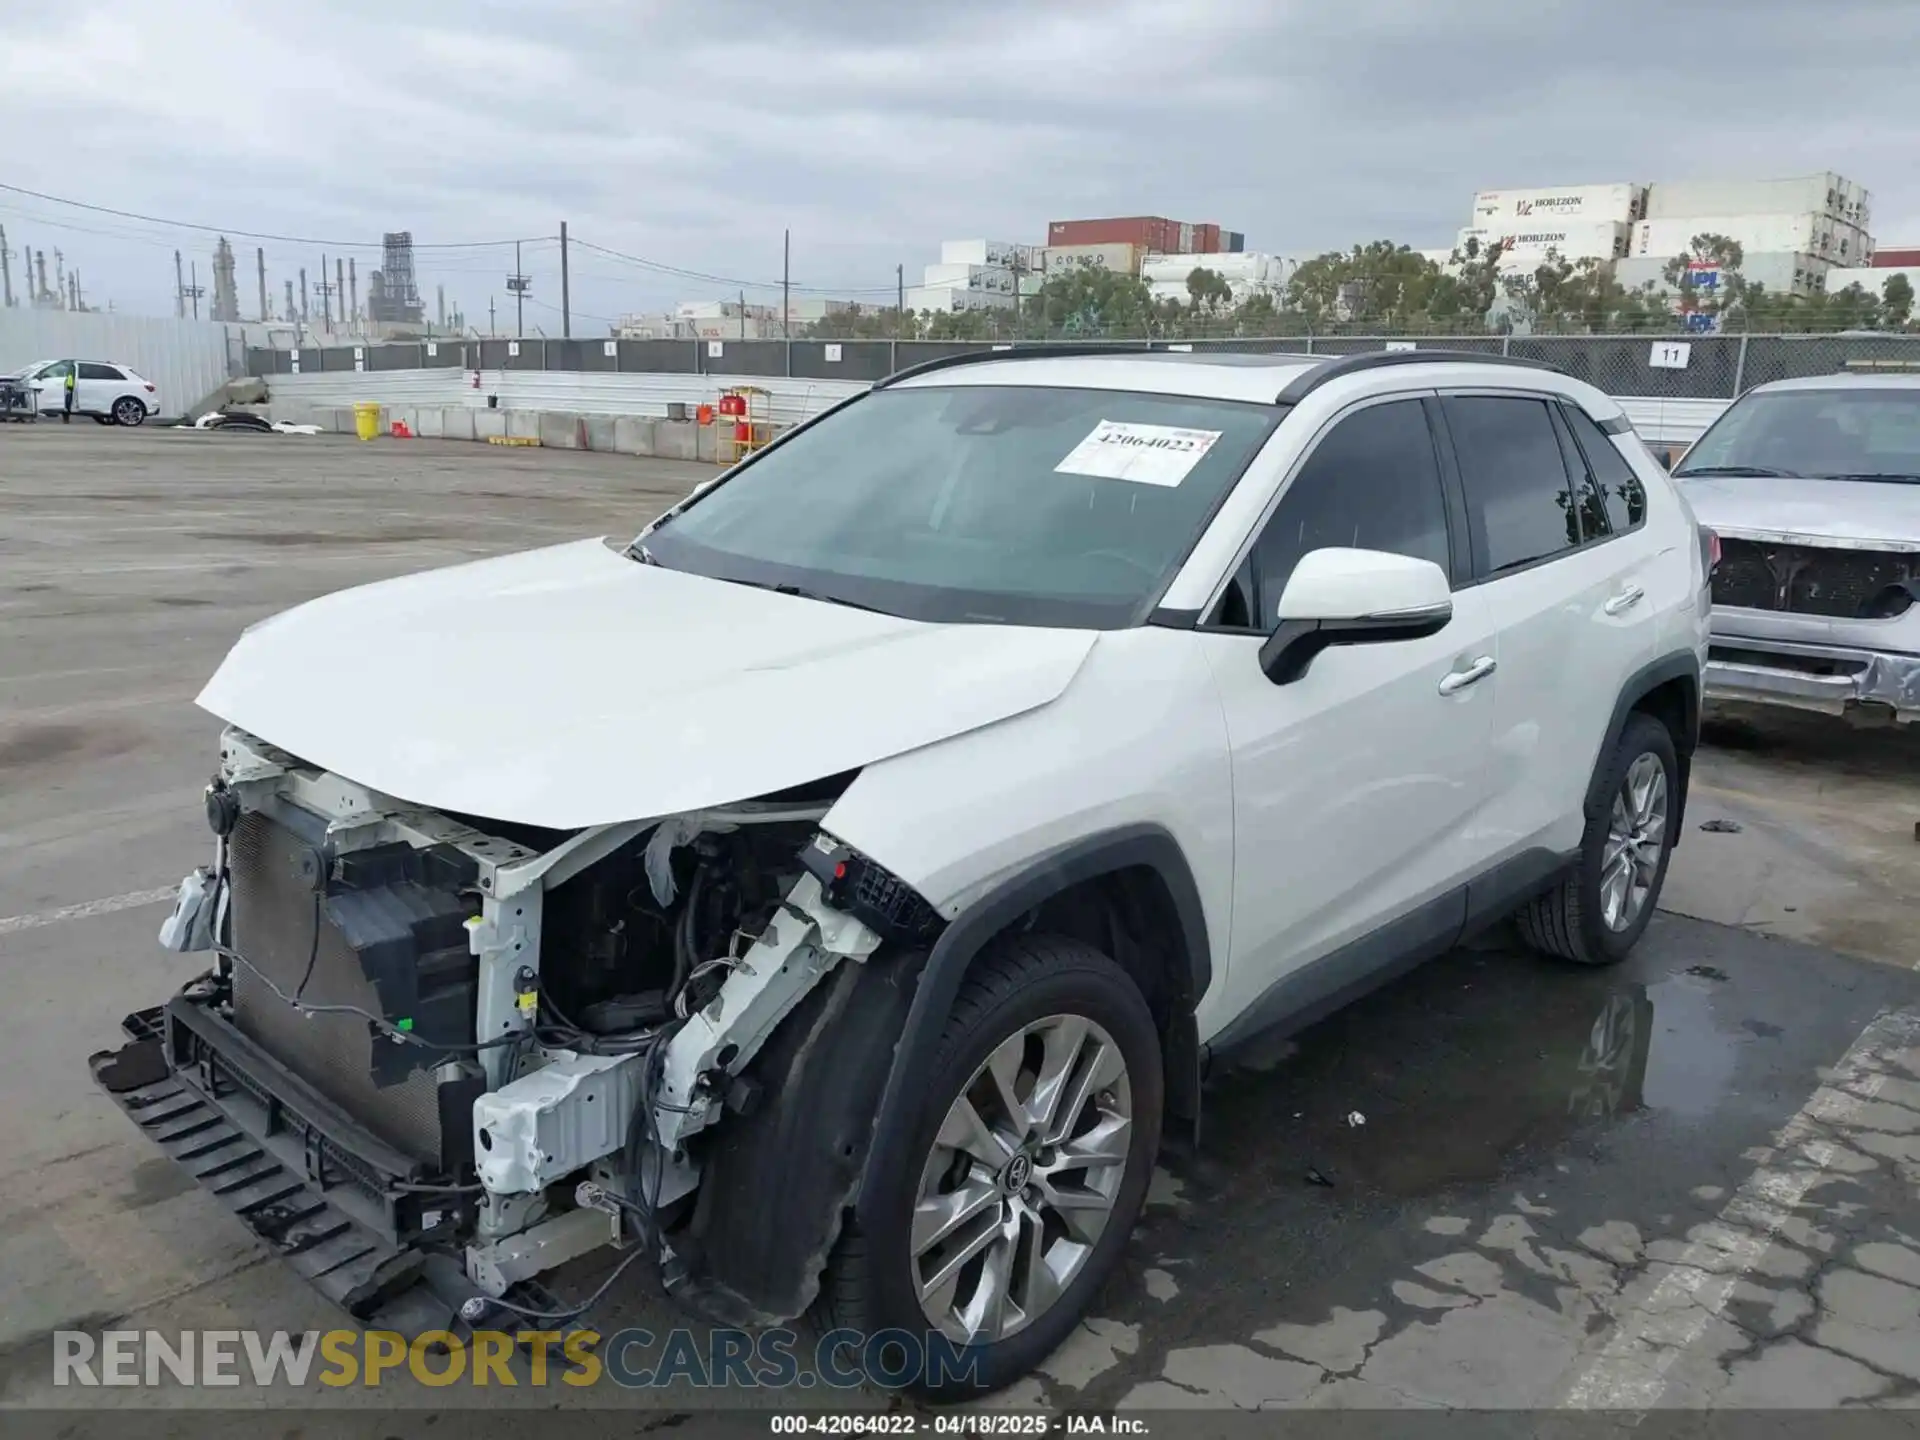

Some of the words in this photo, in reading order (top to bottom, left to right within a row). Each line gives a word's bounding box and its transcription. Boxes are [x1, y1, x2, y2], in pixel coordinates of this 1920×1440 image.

[1535, 196, 1582, 207] HORIZON
[1517, 233, 1566, 243] HORIZON
[1663, 348, 1679, 361] 11
[1098, 433, 1194, 452] 42064022
